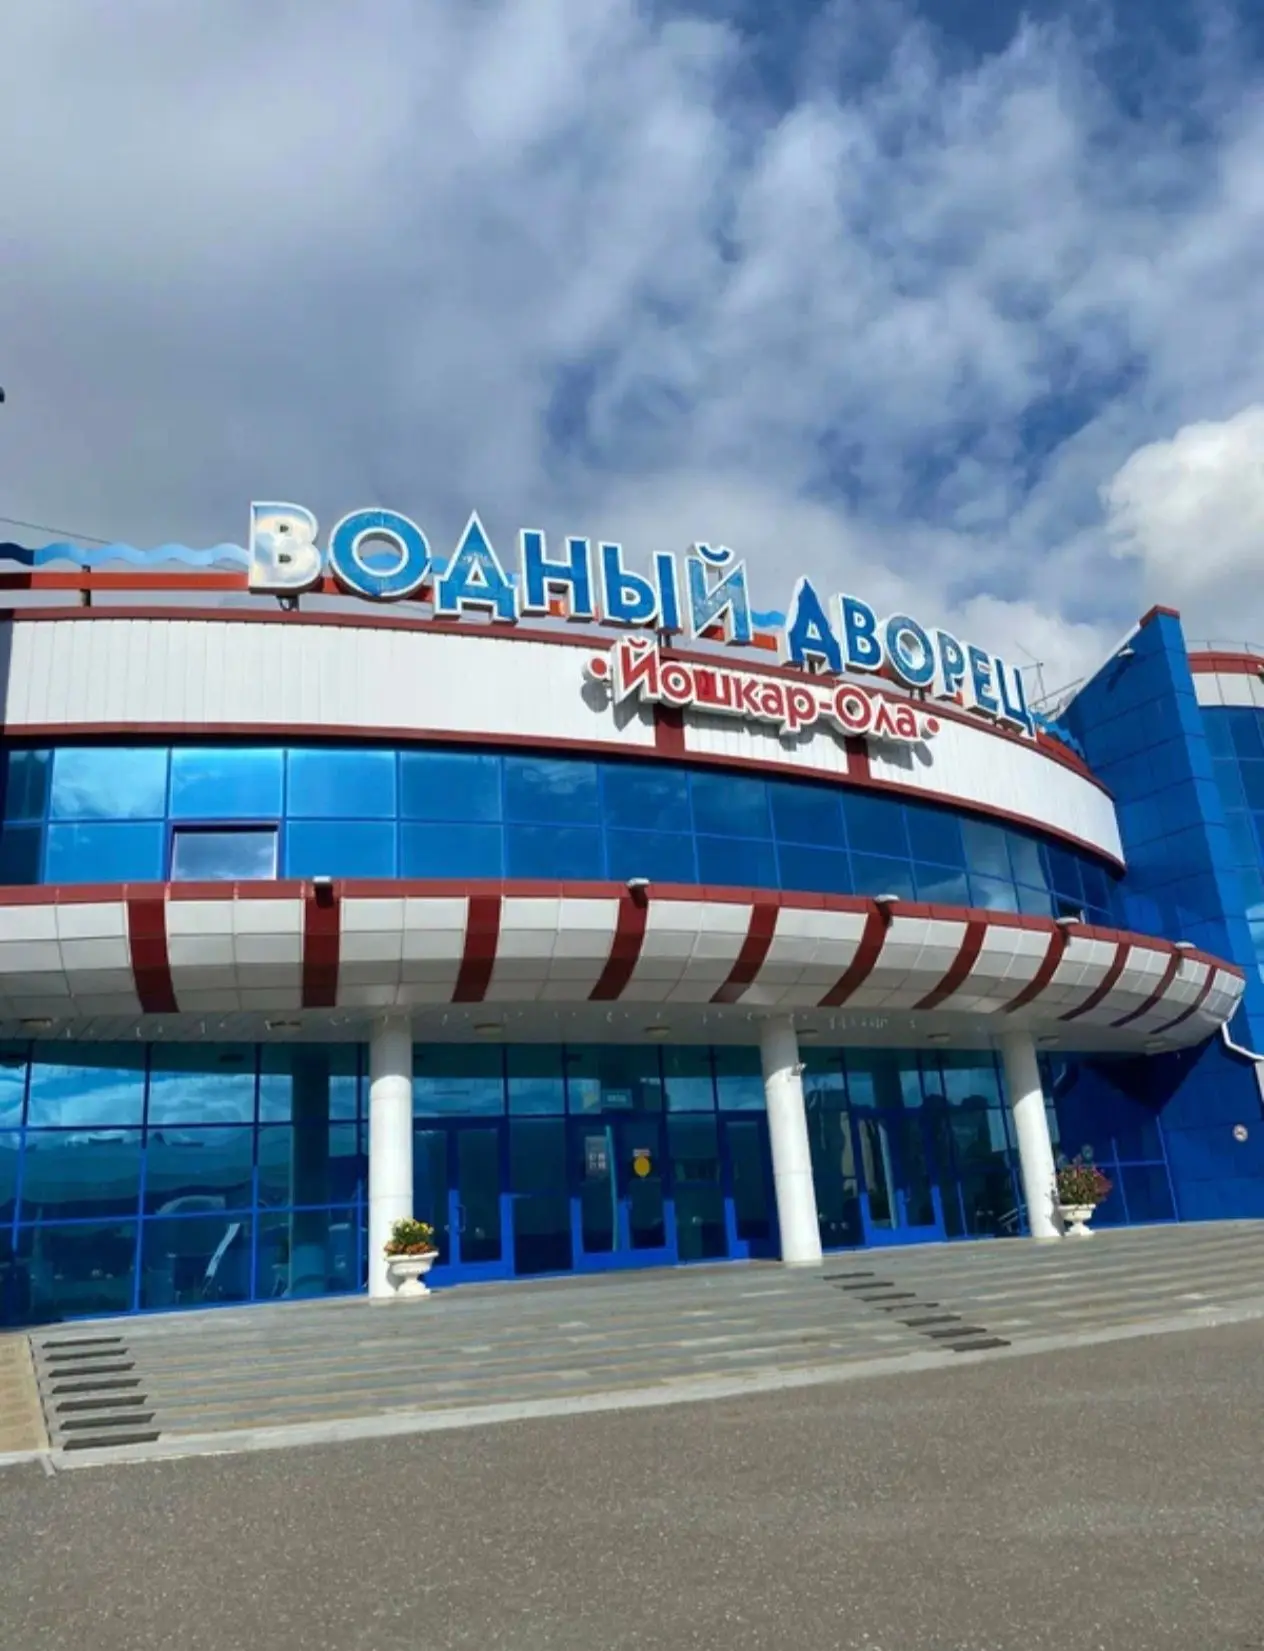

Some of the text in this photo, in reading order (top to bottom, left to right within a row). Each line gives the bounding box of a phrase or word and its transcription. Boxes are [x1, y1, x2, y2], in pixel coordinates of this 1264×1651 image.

[249, 500, 1036, 739] ВОДНЫЙ ДВОРЕЦ
[606, 636, 920, 740] Йошкар-Ола
